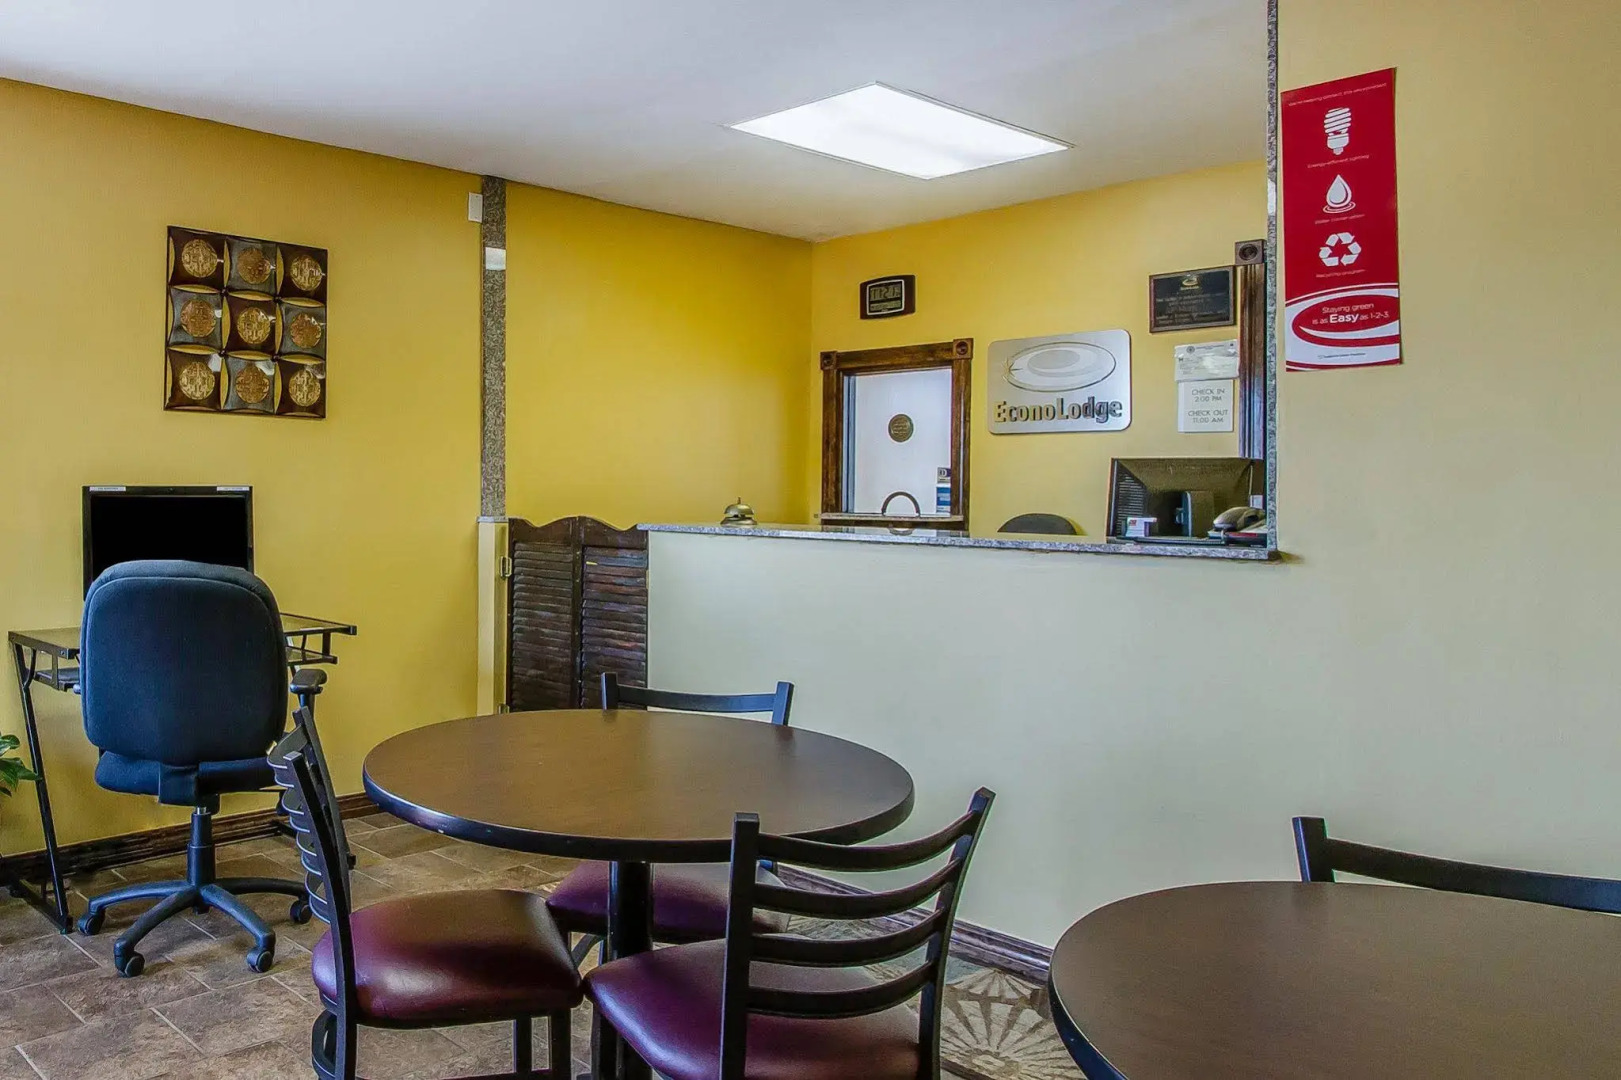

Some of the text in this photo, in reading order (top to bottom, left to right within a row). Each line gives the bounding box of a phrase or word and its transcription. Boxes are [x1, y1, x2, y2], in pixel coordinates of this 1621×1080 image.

[1352, 303, 1374, 311] green
[1329, 313, 1359, 323] Easy
[1191, 388, 1214, 396] CHECK
[994, 396, 1123, 424] EconoLodge
[1187, 409, 1211, 417] CHECK
